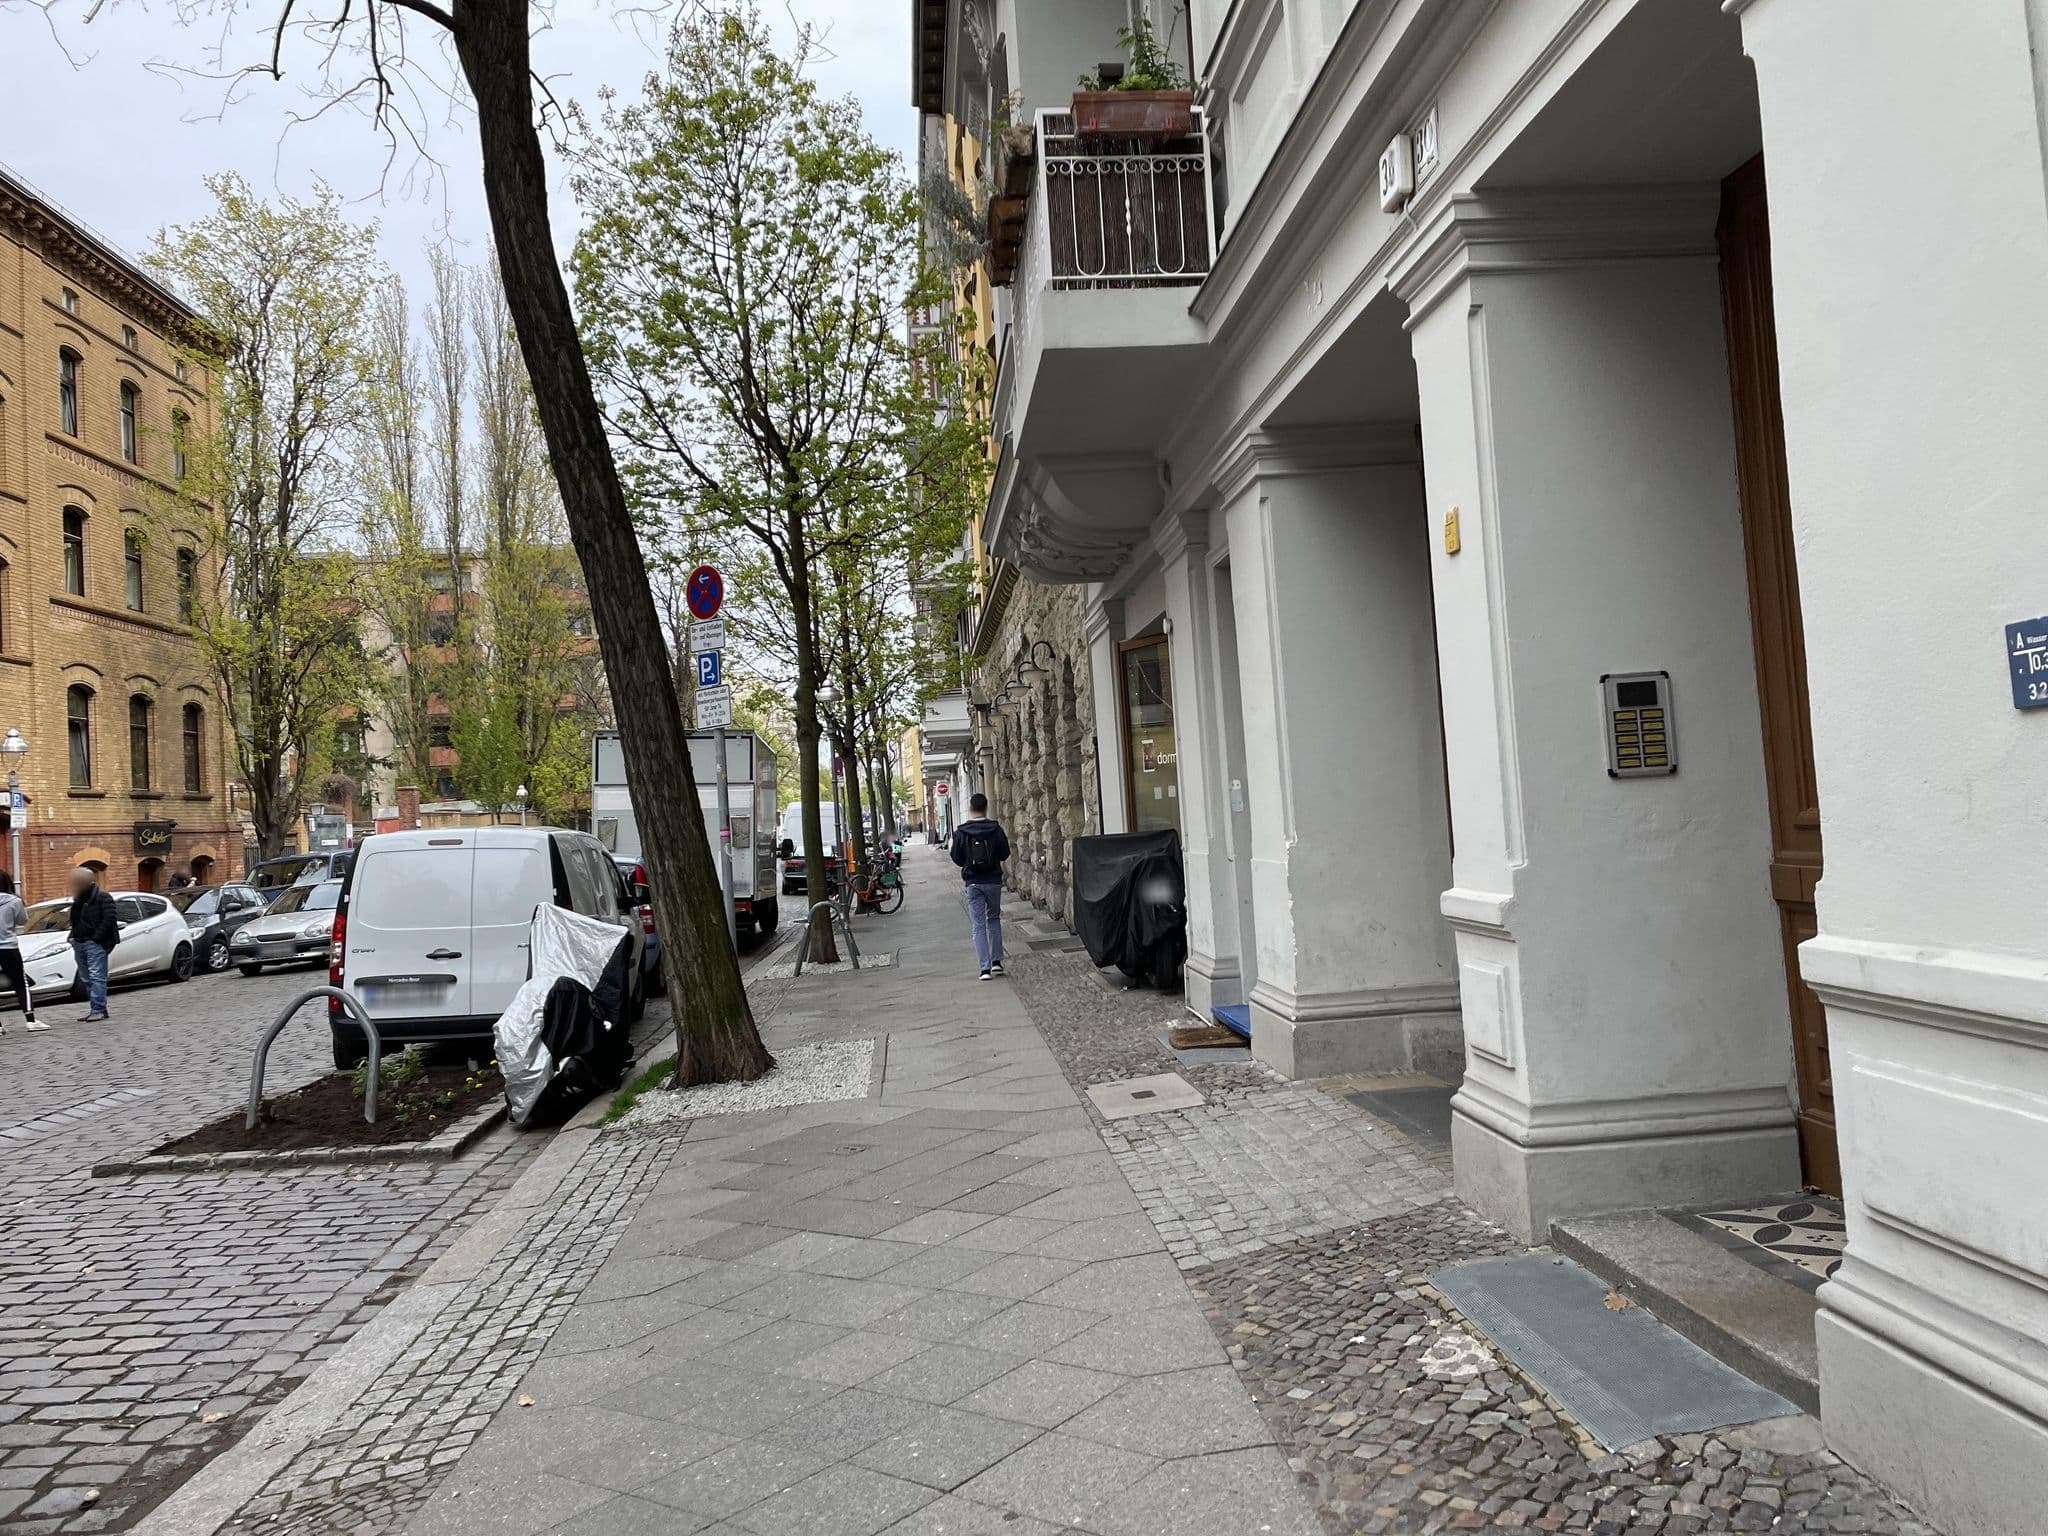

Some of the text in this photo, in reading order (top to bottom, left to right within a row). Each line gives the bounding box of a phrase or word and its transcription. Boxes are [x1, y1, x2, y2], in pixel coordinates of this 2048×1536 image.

[1416, 118, 1434, 164] 30
[2017, 632, 2024, 649] A
[700, 657, 712, 682] P
[14, 794, 21, 806] P
